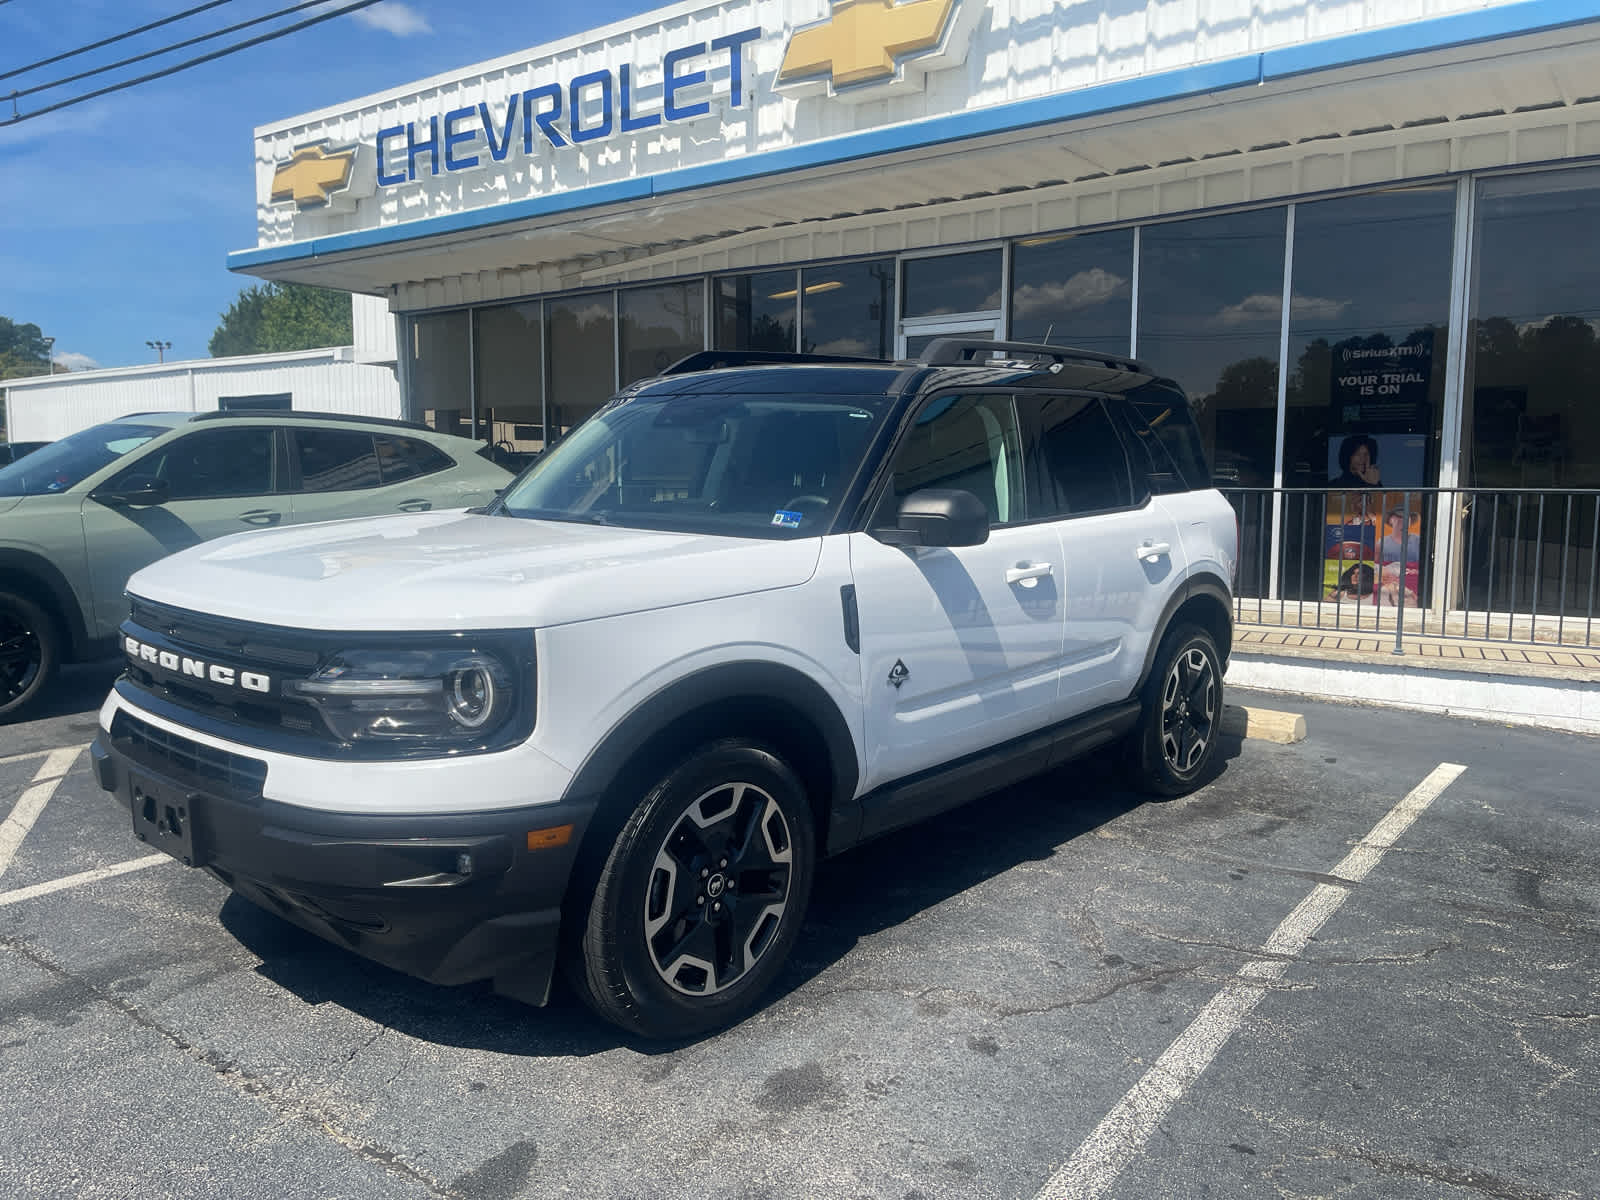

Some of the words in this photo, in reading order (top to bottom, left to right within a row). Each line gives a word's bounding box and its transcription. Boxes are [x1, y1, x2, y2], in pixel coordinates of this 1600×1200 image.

[376, 26, 762, 187] CHEVROLET
[1338, 375, 1378, 386] YOUR
[1382, 374, 1424, 383] TRIAL
[1360, 385, 1375, 396] IS
[1378, 385, 1400, 394] ON
[125, 636, 270, 693] BRONCO
